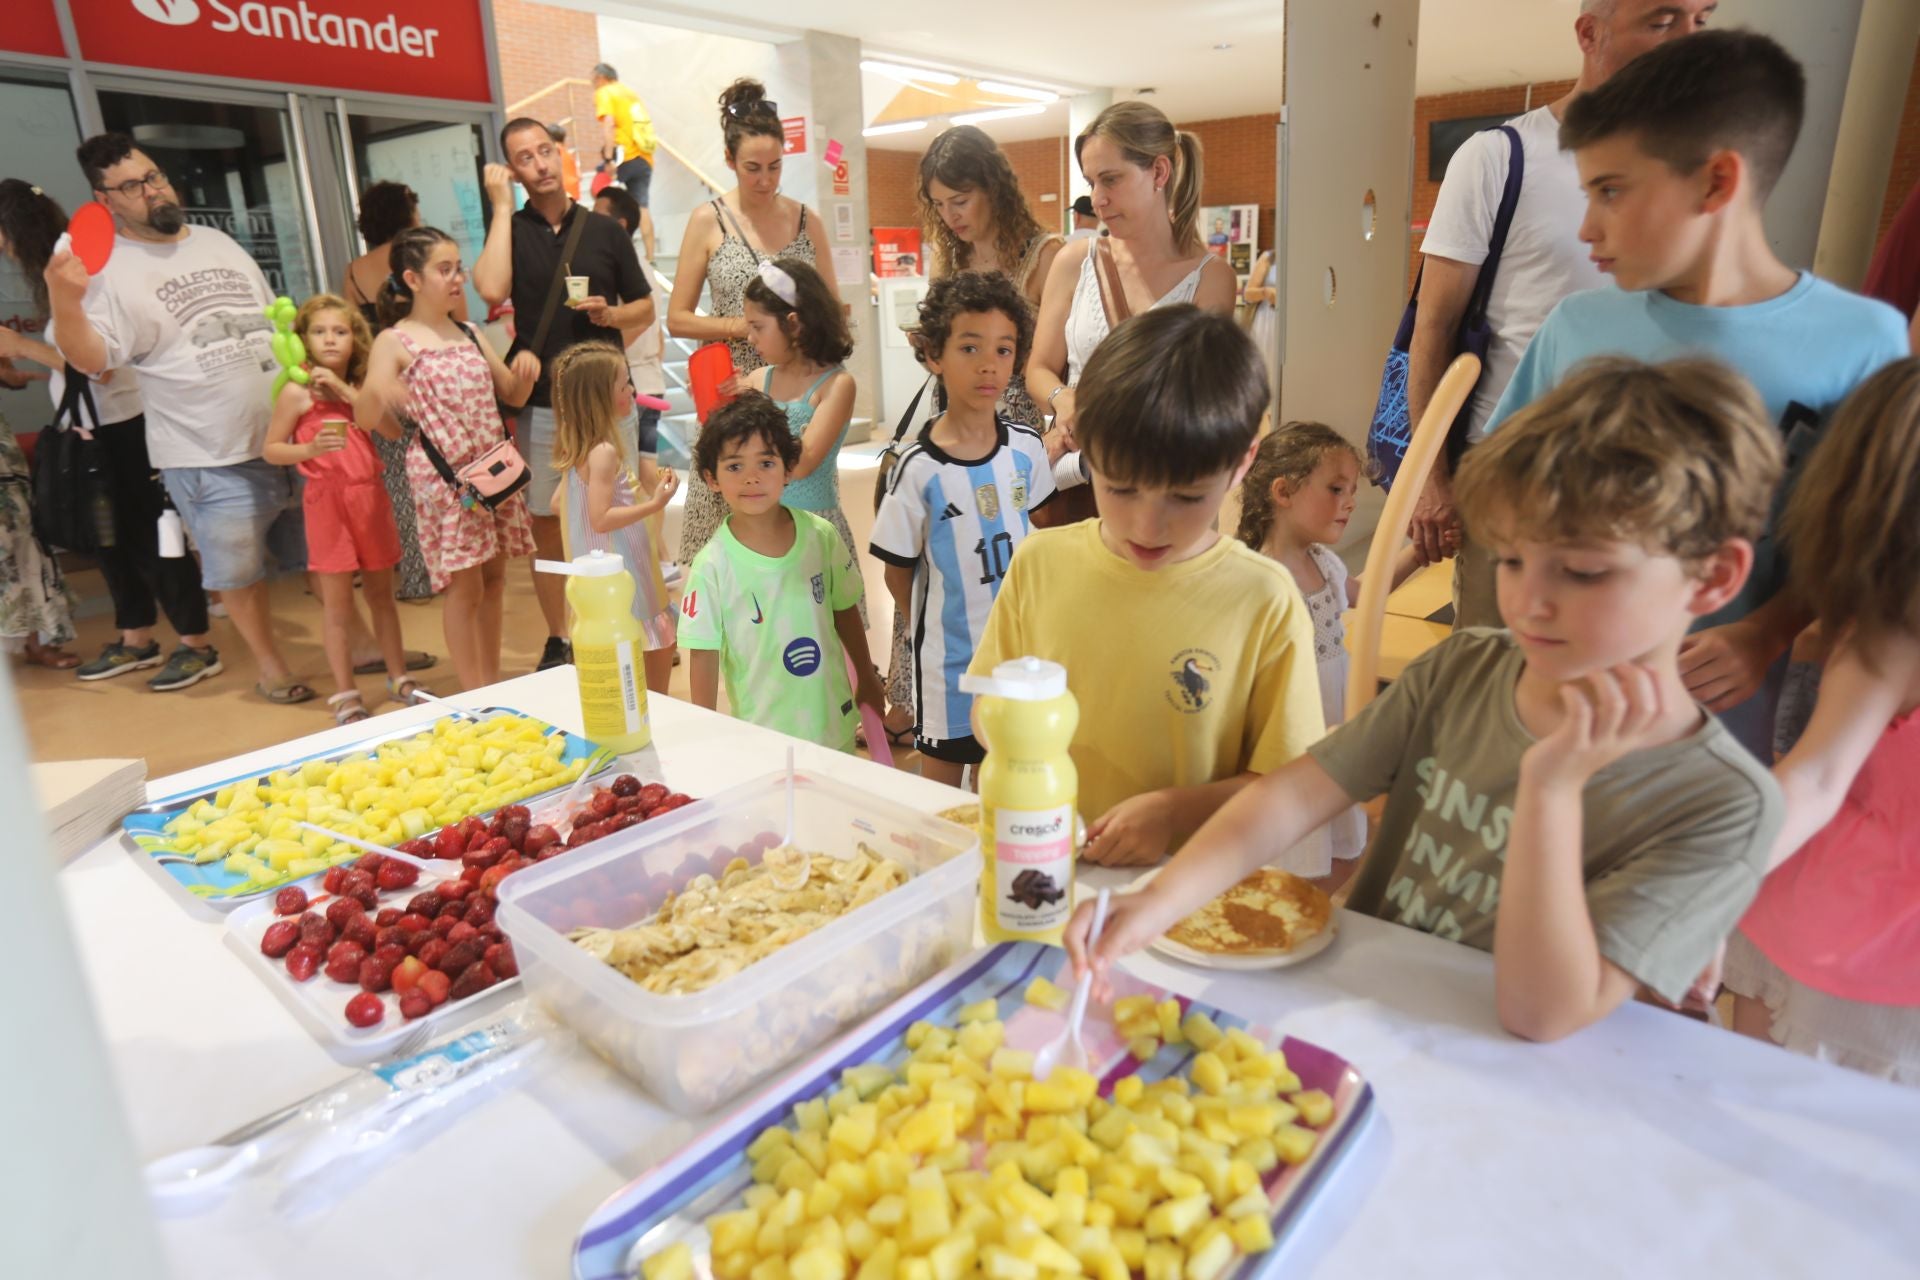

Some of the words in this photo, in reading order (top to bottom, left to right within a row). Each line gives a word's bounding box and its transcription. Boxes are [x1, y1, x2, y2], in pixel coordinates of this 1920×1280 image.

[207, 0, 439, 58] Santander
[974, 532, 1013, 584] 10
[1010, 821, 1060, 837] cresco
